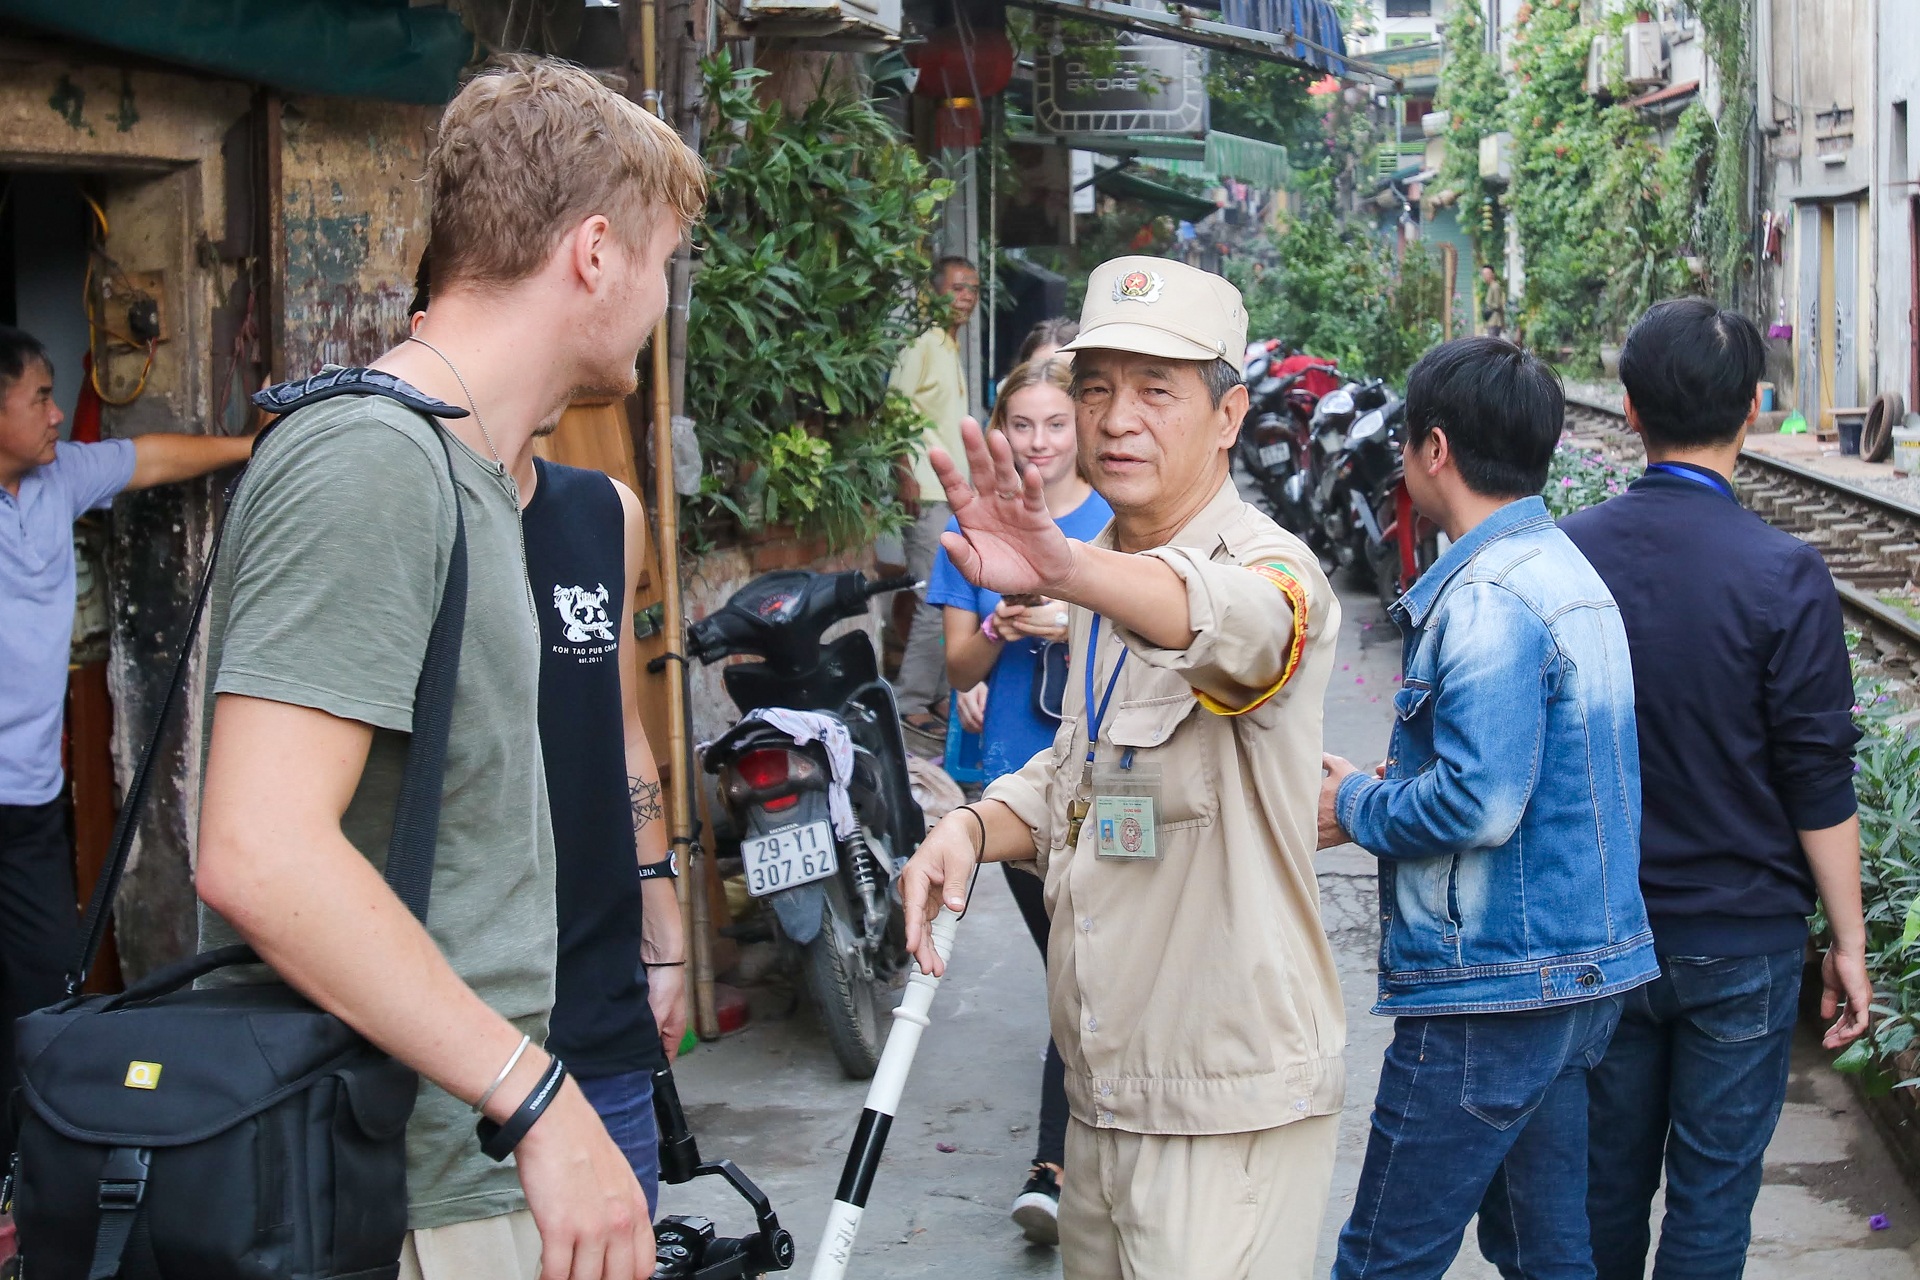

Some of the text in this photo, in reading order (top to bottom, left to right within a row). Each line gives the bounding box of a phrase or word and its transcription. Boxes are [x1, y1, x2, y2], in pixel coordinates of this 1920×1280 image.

[552, 645, 569, 654] KOH
[572, 647, 586, 655] TAO
[588, 647, 603, 655] PUB
[769, 822, 799, 834] HONDA
[755, 826, 817, 864] 29-Y1
[752, 850, 830, 890] 307.62
